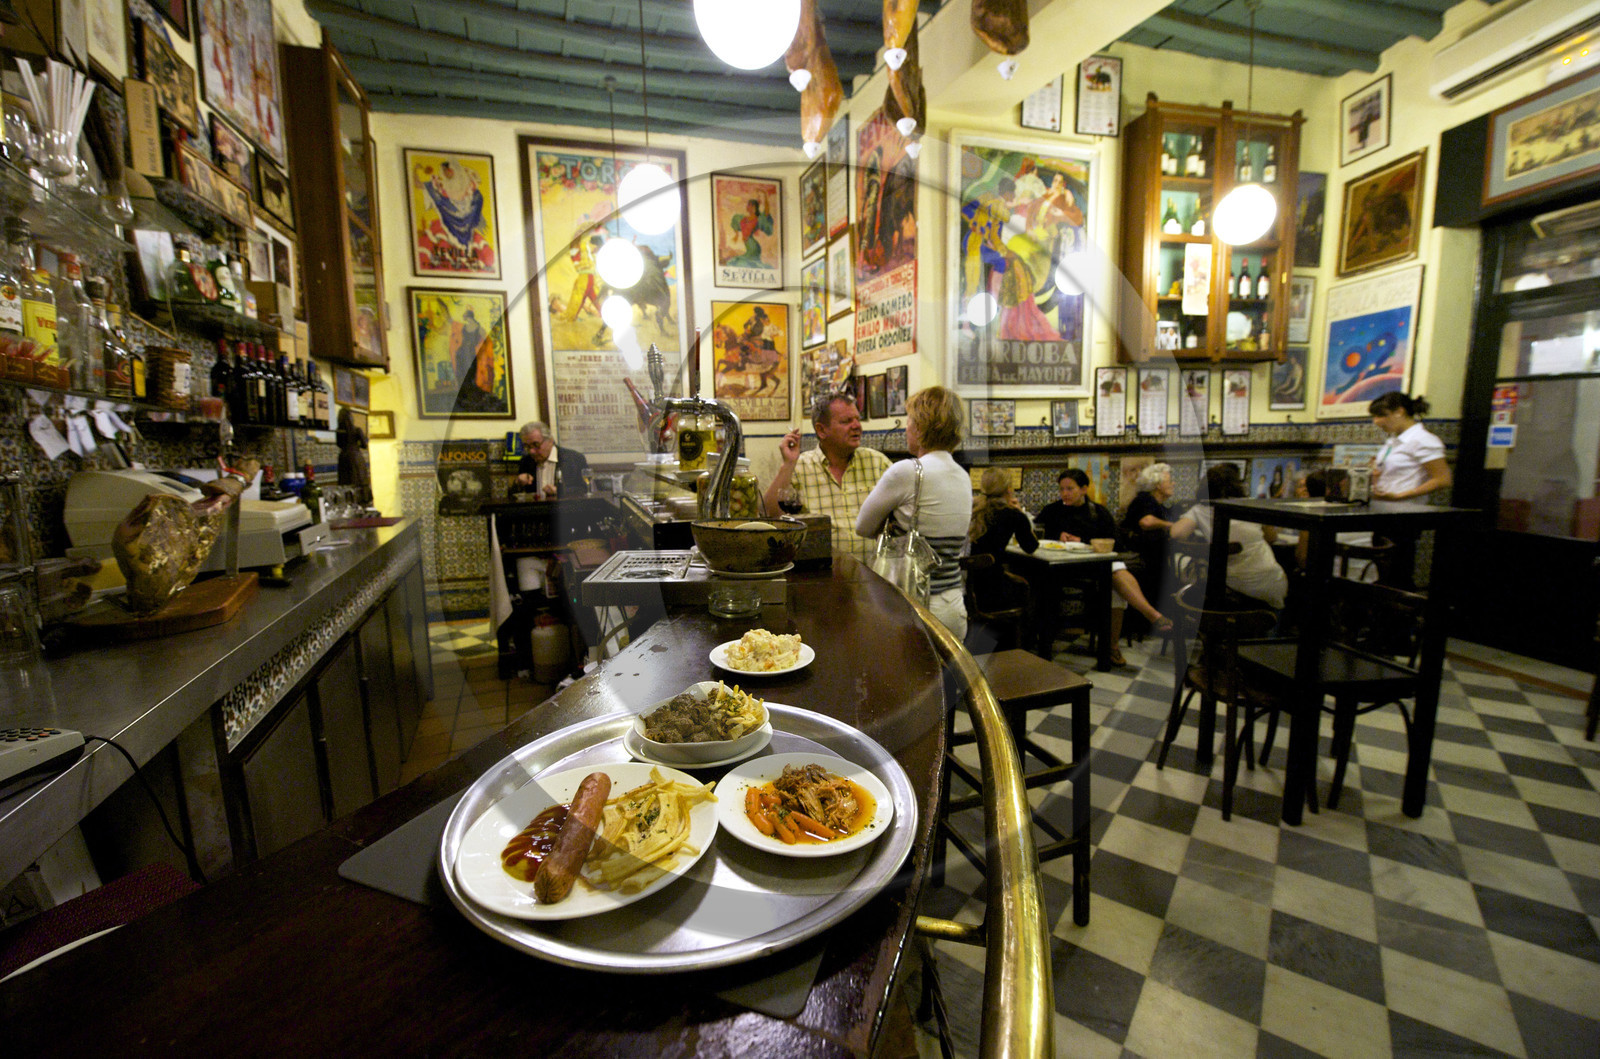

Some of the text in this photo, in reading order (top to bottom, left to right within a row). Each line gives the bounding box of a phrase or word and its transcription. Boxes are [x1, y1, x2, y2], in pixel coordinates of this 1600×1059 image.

[722, 269, 776, 281] SEVILLA
[858, 291, 913, 325] CURRO ROMERO
[857, 319, 880, 340] EMILIO
[856, 335, 877, 355] RIVERA
[961, 366, 1001, 383] FERIA
[733, 398, 774, 408] SEVILLA
[437, 451, 487, 461] ALFONSO
